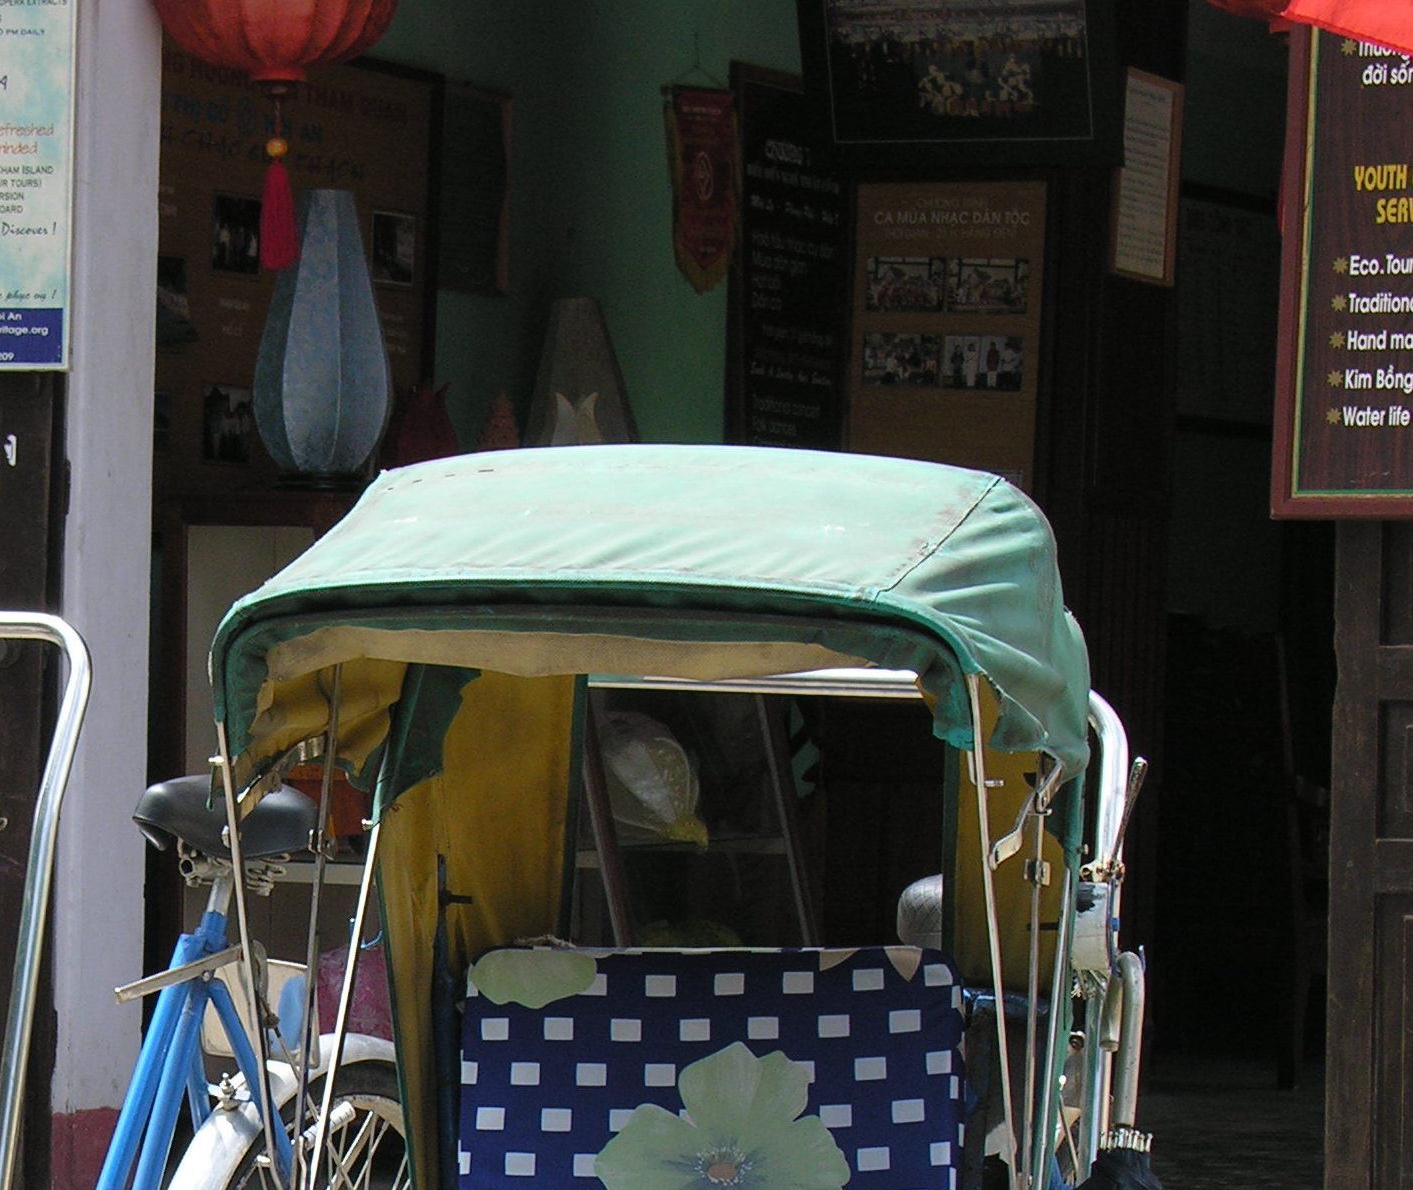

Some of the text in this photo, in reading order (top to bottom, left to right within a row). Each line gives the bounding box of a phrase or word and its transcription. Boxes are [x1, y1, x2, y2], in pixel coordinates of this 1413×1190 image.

[1362, 63, 1388, 86] đời
[22, 165, 54, 175] ISLAND
[1354, 164, 1408, 191] YOUTH
[874, 210, 894, 225] CA
[1, 221, 48, 236] Discover
[7, 312, 22, 321] An
[1347, 330, 1387, 351] Hand
[1344, 364, 1413, 394] Kim Bồng
[1342, 405, 1411, 427] Water life
